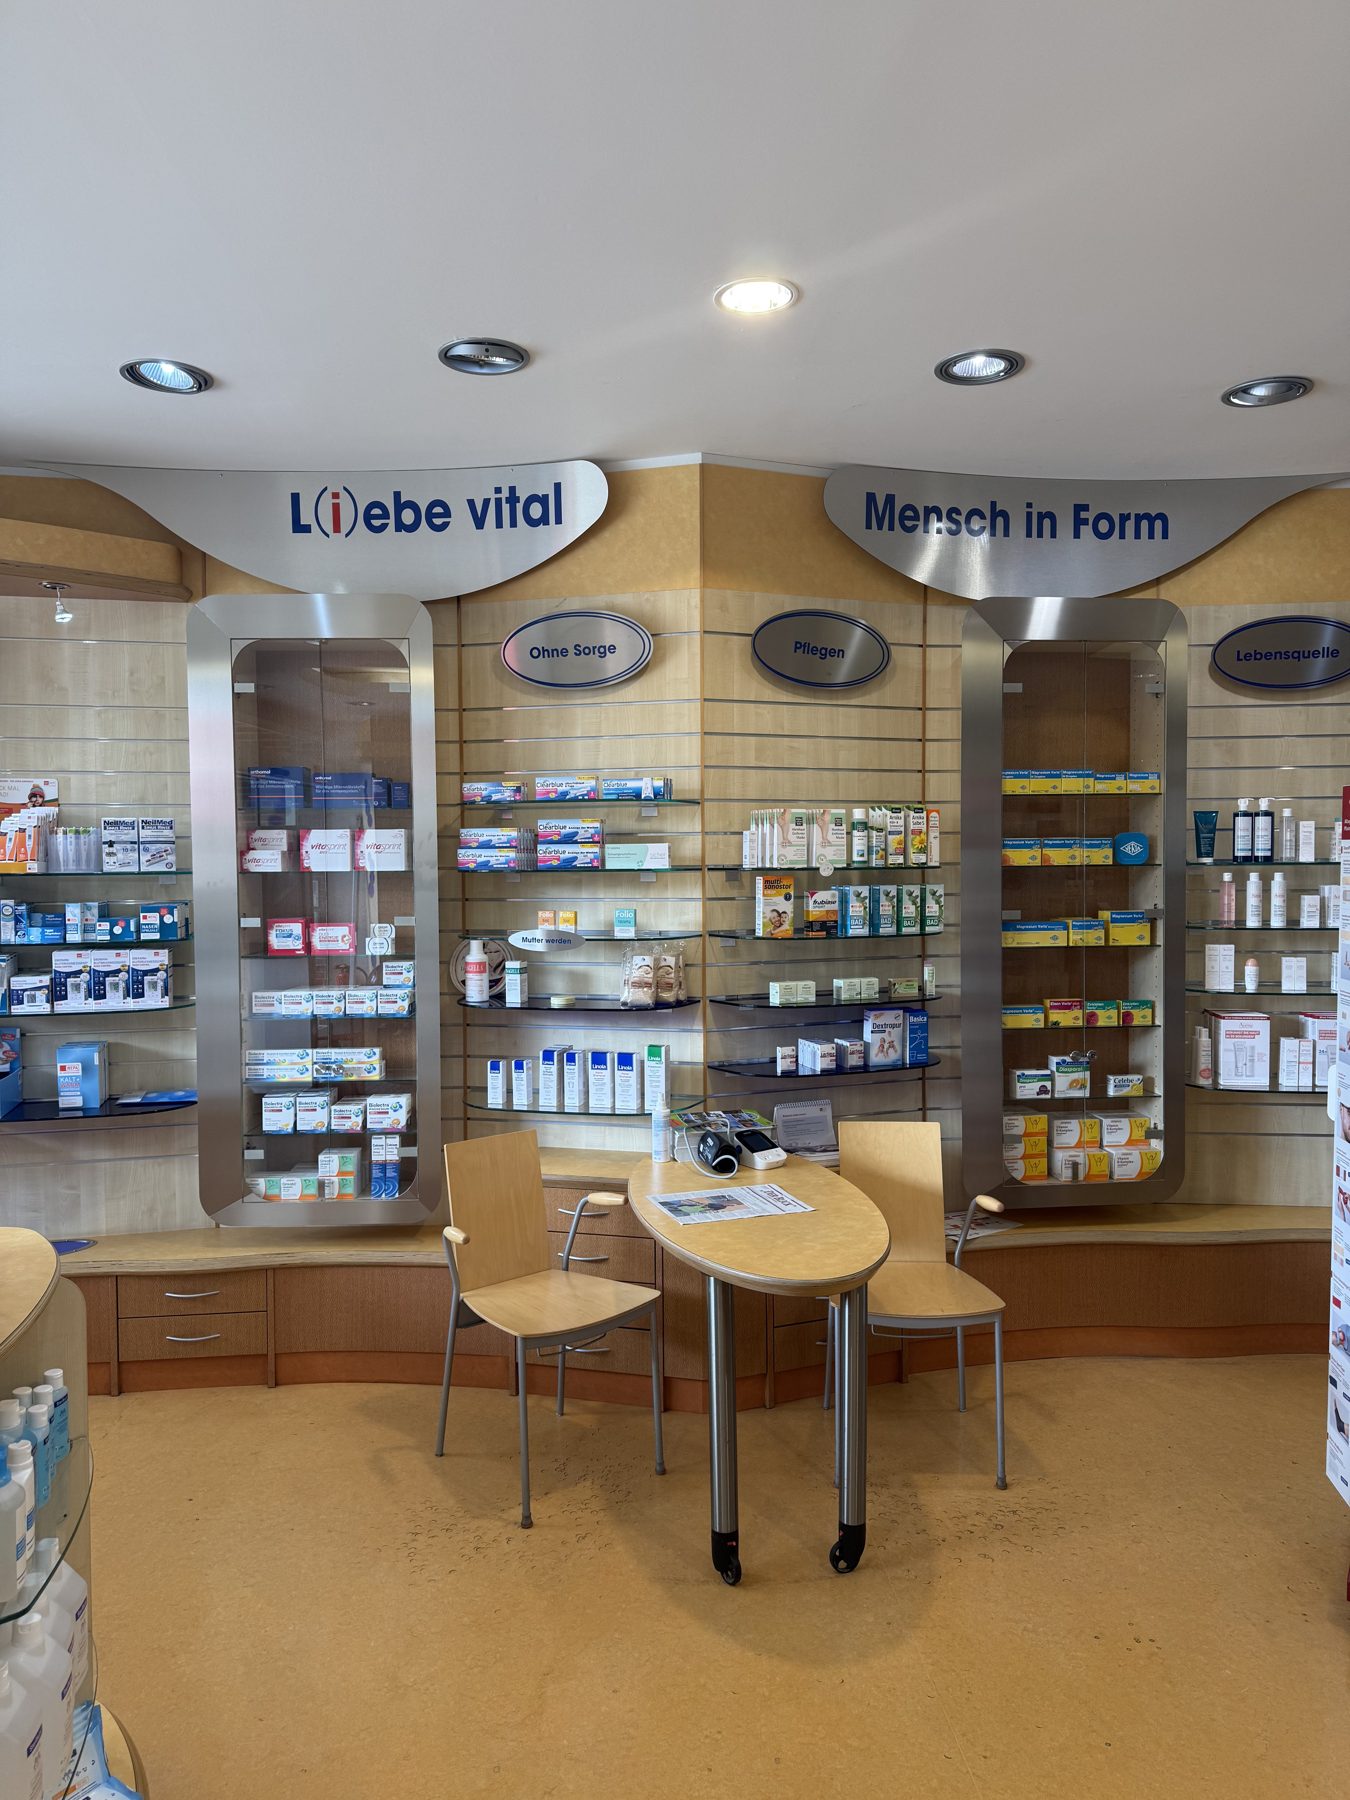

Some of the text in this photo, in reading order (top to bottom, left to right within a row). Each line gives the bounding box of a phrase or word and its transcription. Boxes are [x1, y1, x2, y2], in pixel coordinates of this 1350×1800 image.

[290, 482, 563, 539] L(i)ebe vital
[864, 491, 1169, 540] Mensch in Form
[529, 643, 617, 659] Ohne Sorge
[793, 641, 845, 660] Pflegen
[1236, 646, 1340, 663] Lebensquelle
[311, 842, 348, 852] vitasprint
[366, 842, 402, 852] vitasprint
[522, 936, 572, 945] Mutter werden
[872, 1022, 902, 1031] Dextropur
